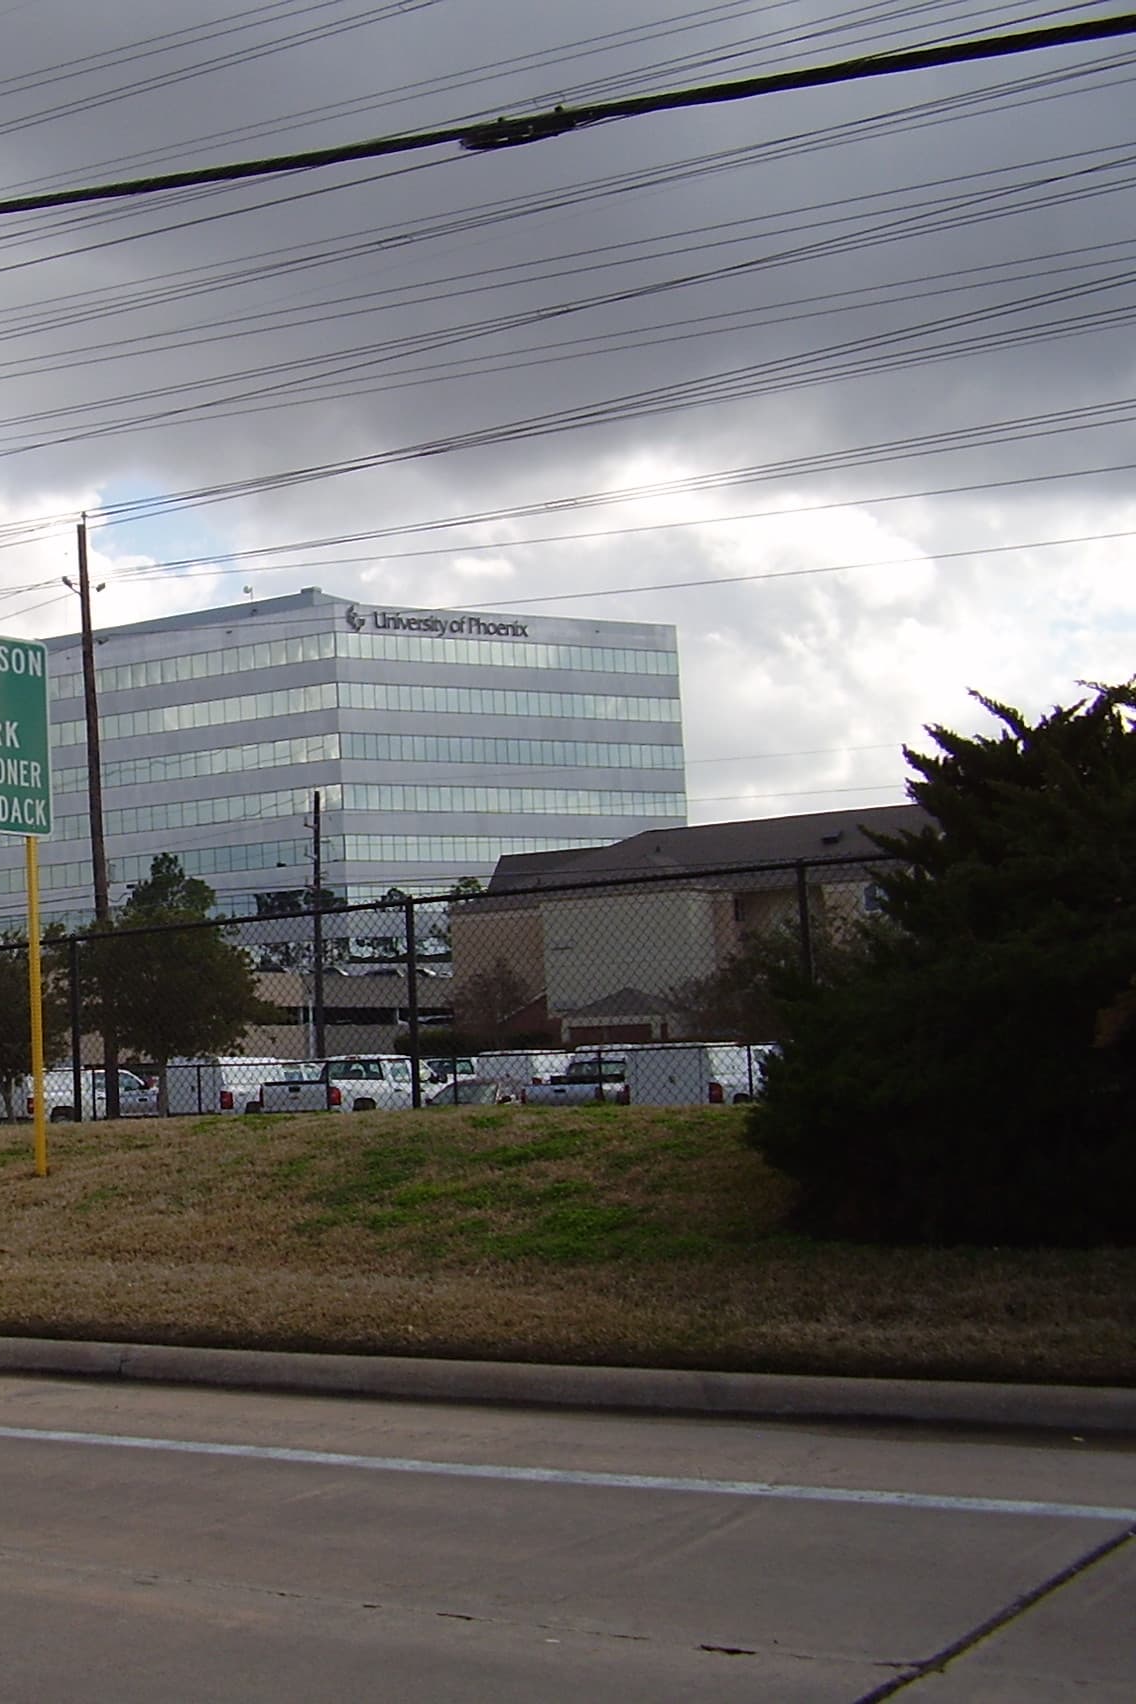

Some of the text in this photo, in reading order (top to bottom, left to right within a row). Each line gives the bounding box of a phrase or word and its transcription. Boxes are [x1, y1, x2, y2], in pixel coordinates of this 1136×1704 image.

[373, 611, 529, 637] University of Phoenix
